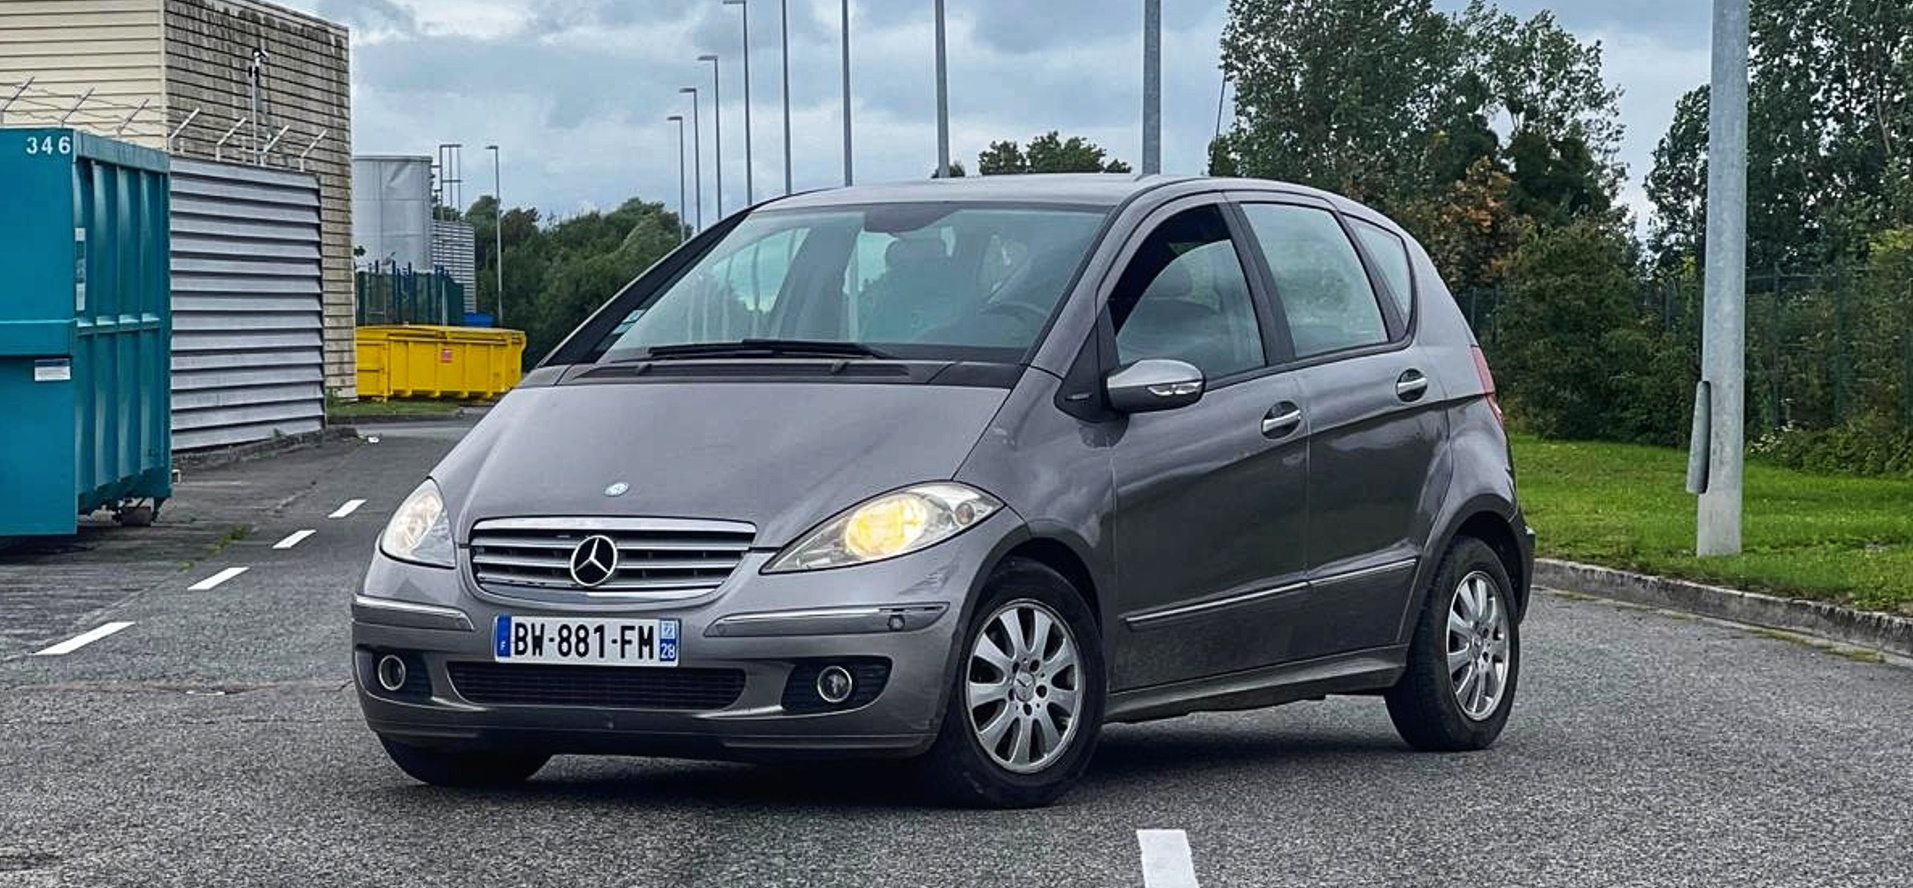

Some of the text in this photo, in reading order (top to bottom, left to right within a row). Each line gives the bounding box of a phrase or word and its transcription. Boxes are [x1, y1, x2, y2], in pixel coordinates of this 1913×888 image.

[26, 135, 71, 155] 346
[514, 622, 654, 660] BW-881-FM
[661, 642, 676, 659] 28
